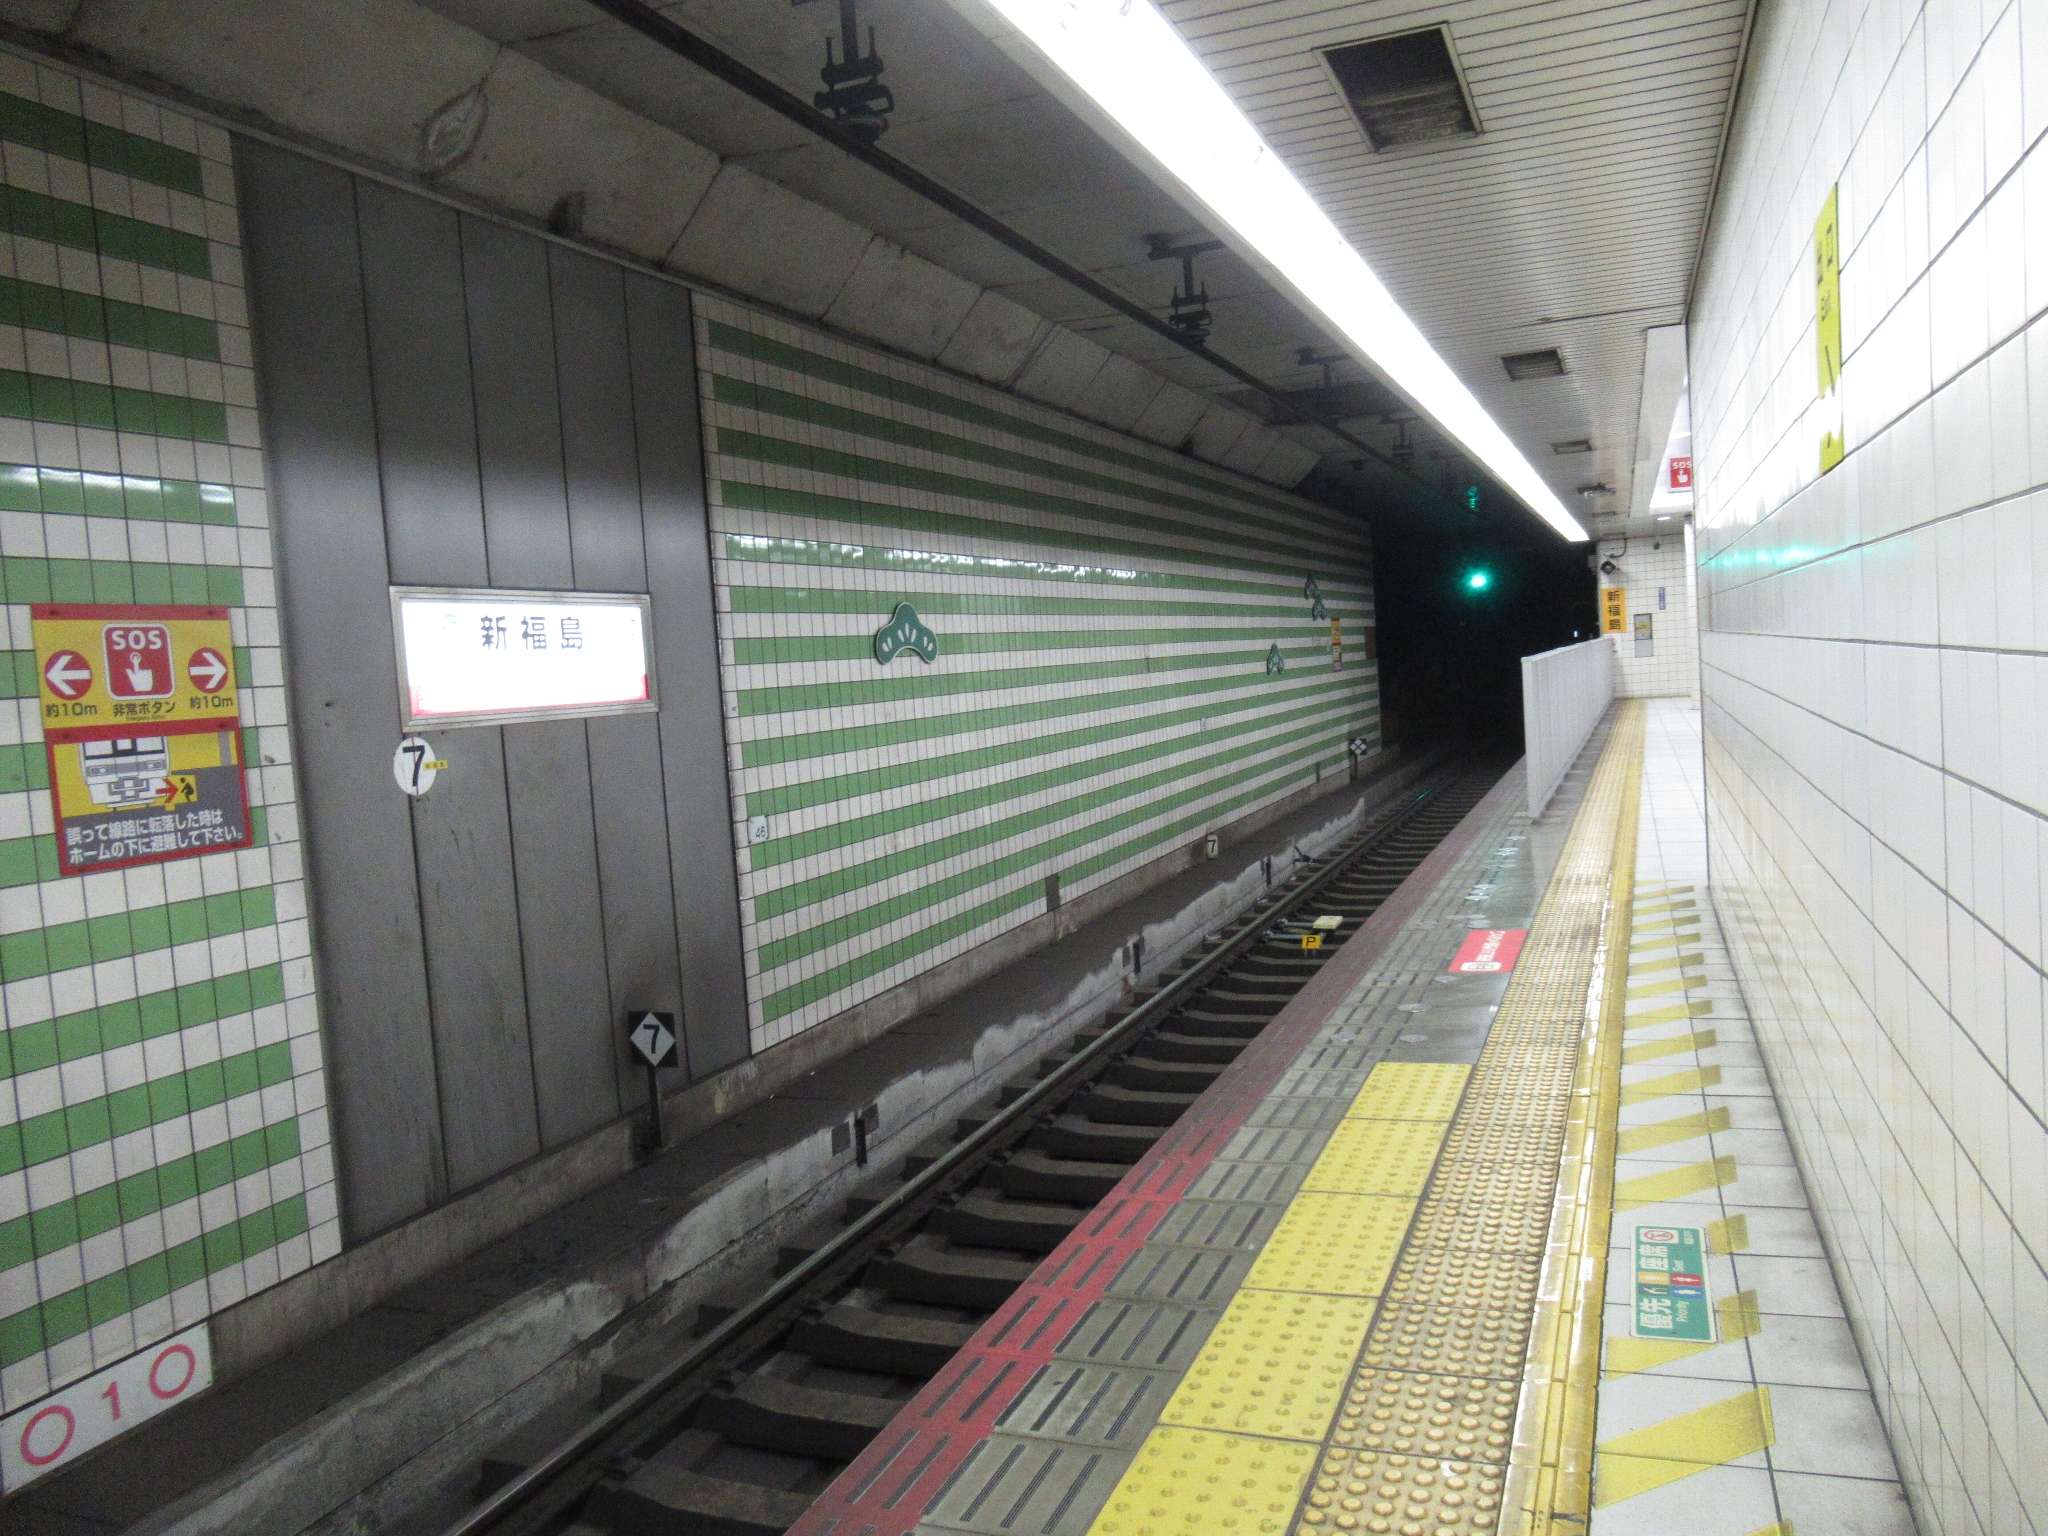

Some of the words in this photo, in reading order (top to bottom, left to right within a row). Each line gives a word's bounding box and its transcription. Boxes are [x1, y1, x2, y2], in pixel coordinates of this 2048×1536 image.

[1672, 461, 1692, 470] SOS
[112, 631, 162, 650] SOS
[480, 615, 583, 650] 新福島
[46, 702, 98, 718] 約10m
[113, 701, 176, 716] 非常ボタン
[190, 695, 233, 710] 約10m
[402, 745, 426, 787] 7
[66, 808, 224, 847] 誤って線路に転落した時は
[69, 825, 243, 865] ホームの下に避難して下さい。
[1208, 839, 1217, 854] 7
[1306, 936, 1317, 948] P
[643, 1023, 660, 1054] 7
[1639, 1244, 1669, 1271] 座席
[1639, 1297, 1674, 1329] 優先
[19, 1343, 197, 1467] 010
